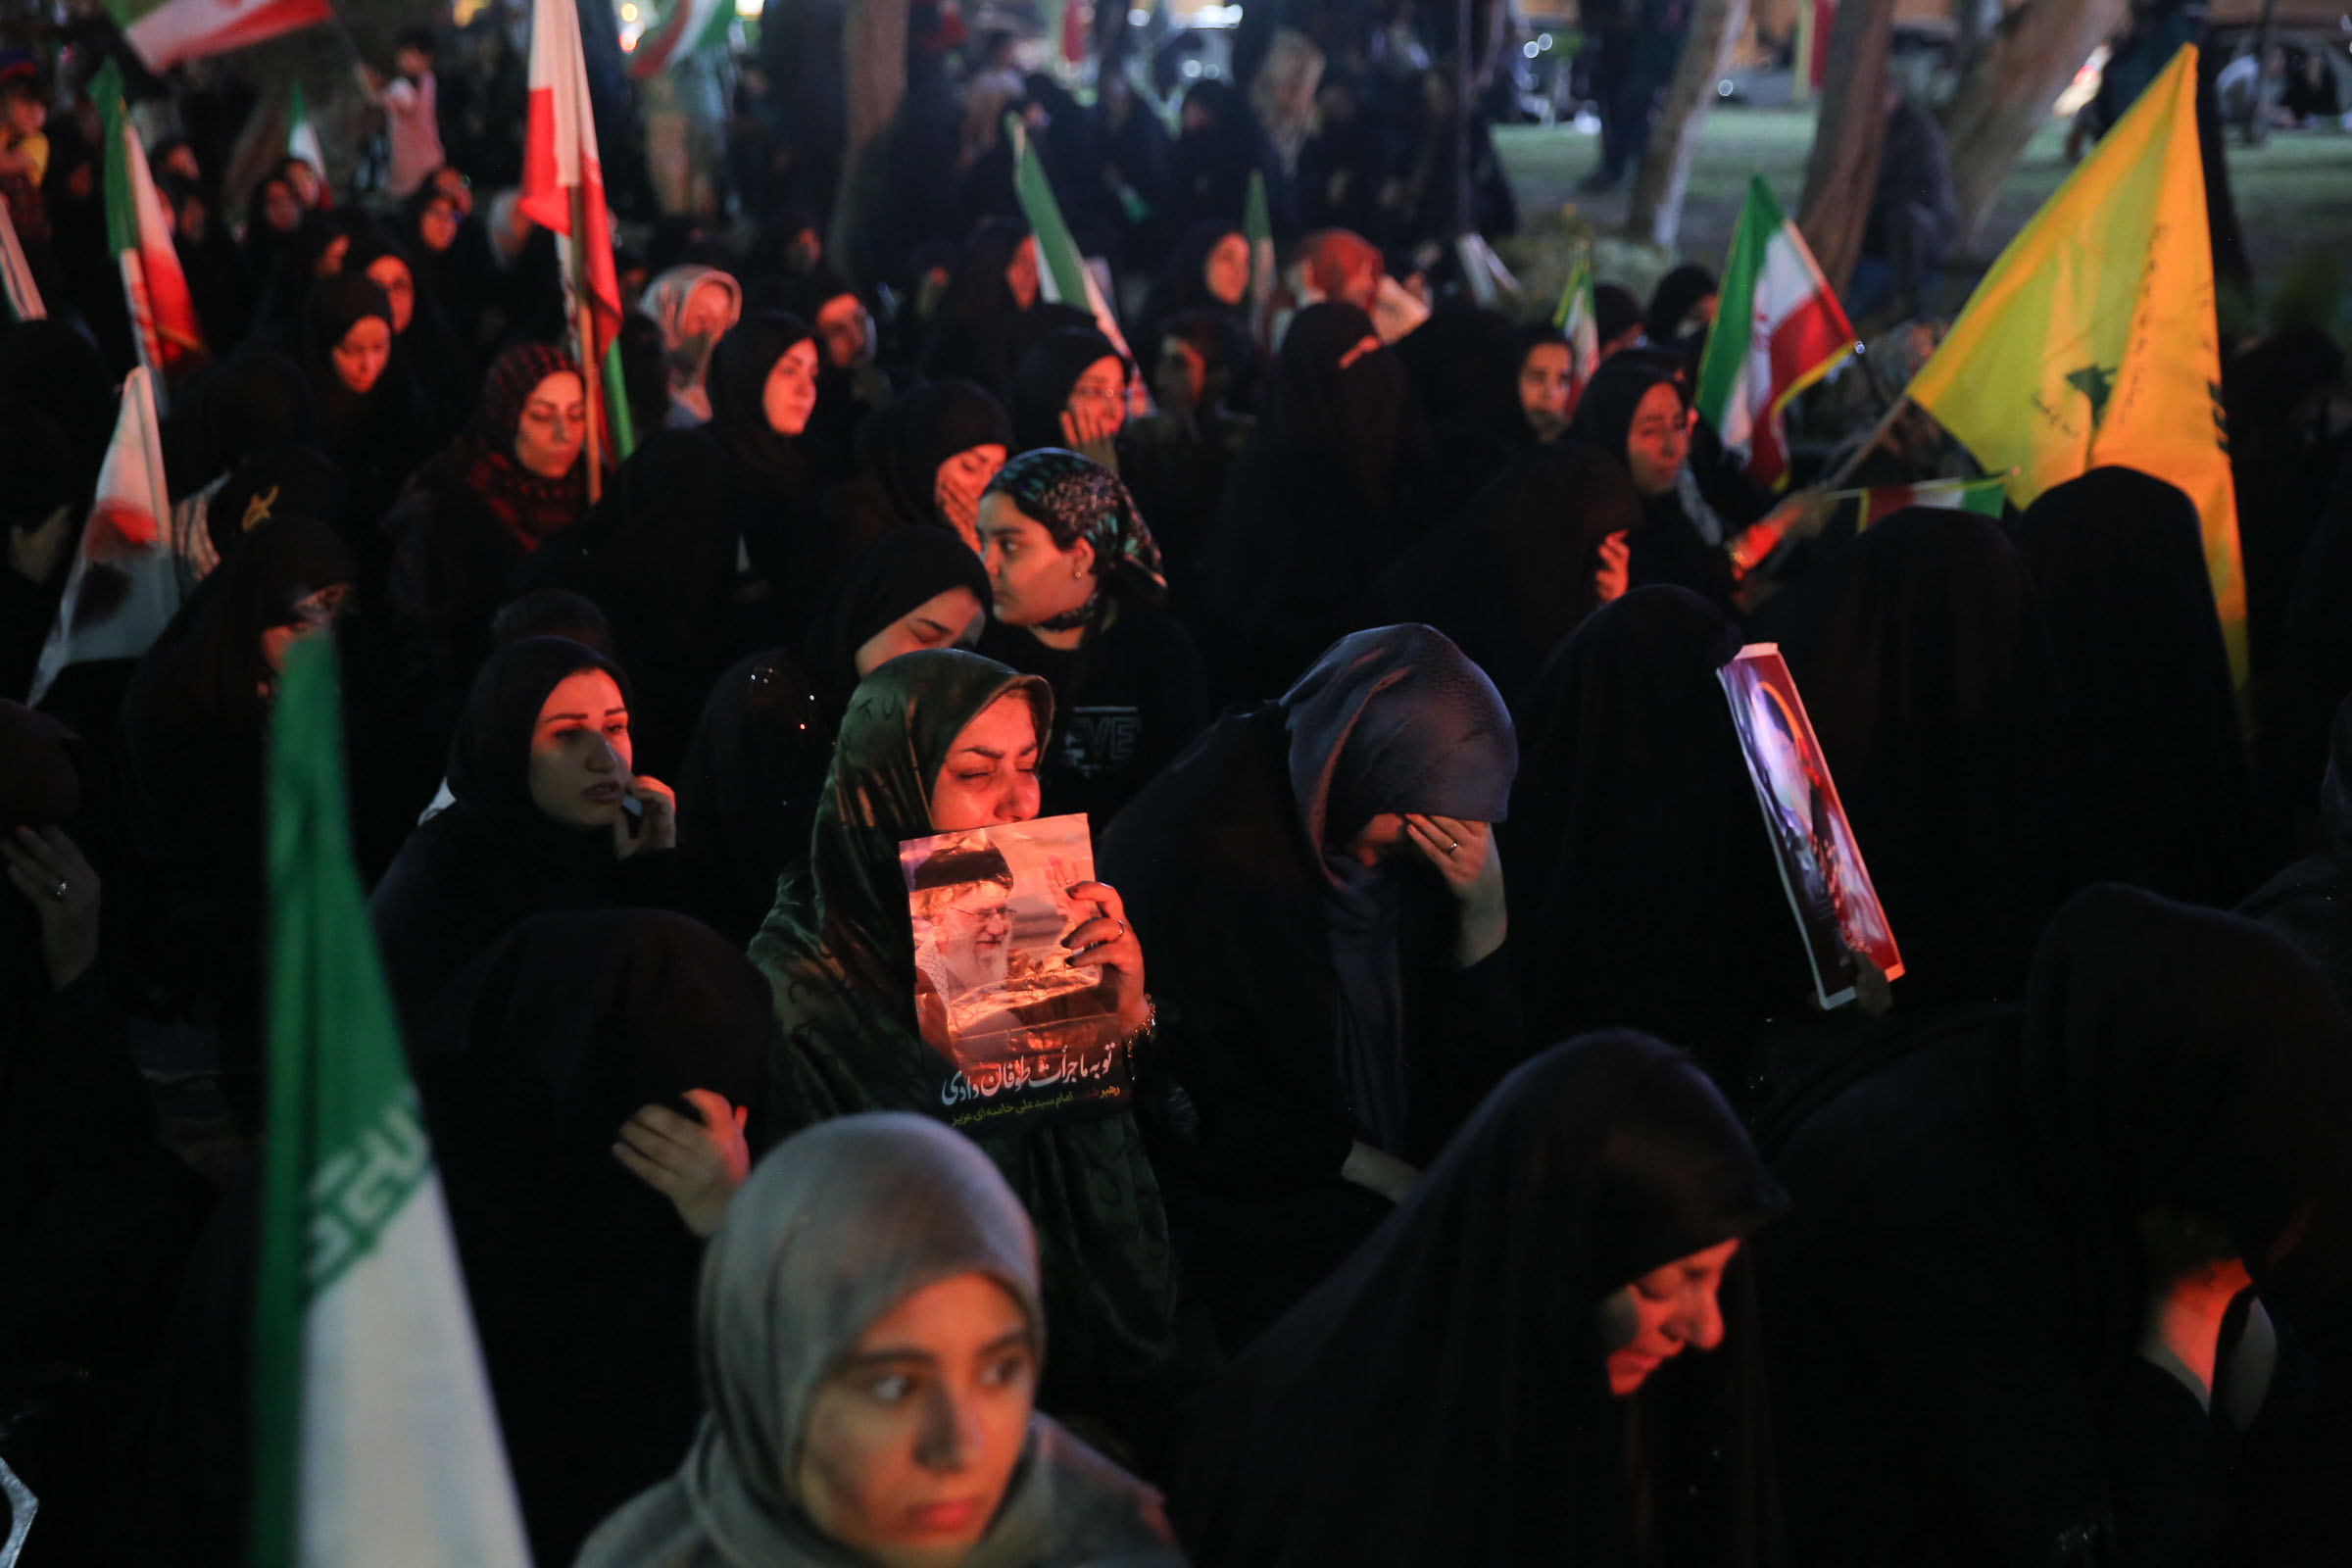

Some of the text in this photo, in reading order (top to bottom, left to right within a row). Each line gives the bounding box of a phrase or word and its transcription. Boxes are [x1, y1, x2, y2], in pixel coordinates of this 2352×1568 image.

[1080, 1053, 1089, 1078] ما
[1102, 1042, 1115, 1074] تو
[981, 1054, 1031, 1098] طوفان
[1089, 1060, 1101, 1080] به
[942, 1069, 980, 1105] دادی
[1100, 1085, 1121, 1099] رهبر
[1015, 1098, 1036, 1114] علی
[1055, 1090, 1074, 1109] امام
[952, 1112, 973, 1127] عزیز
